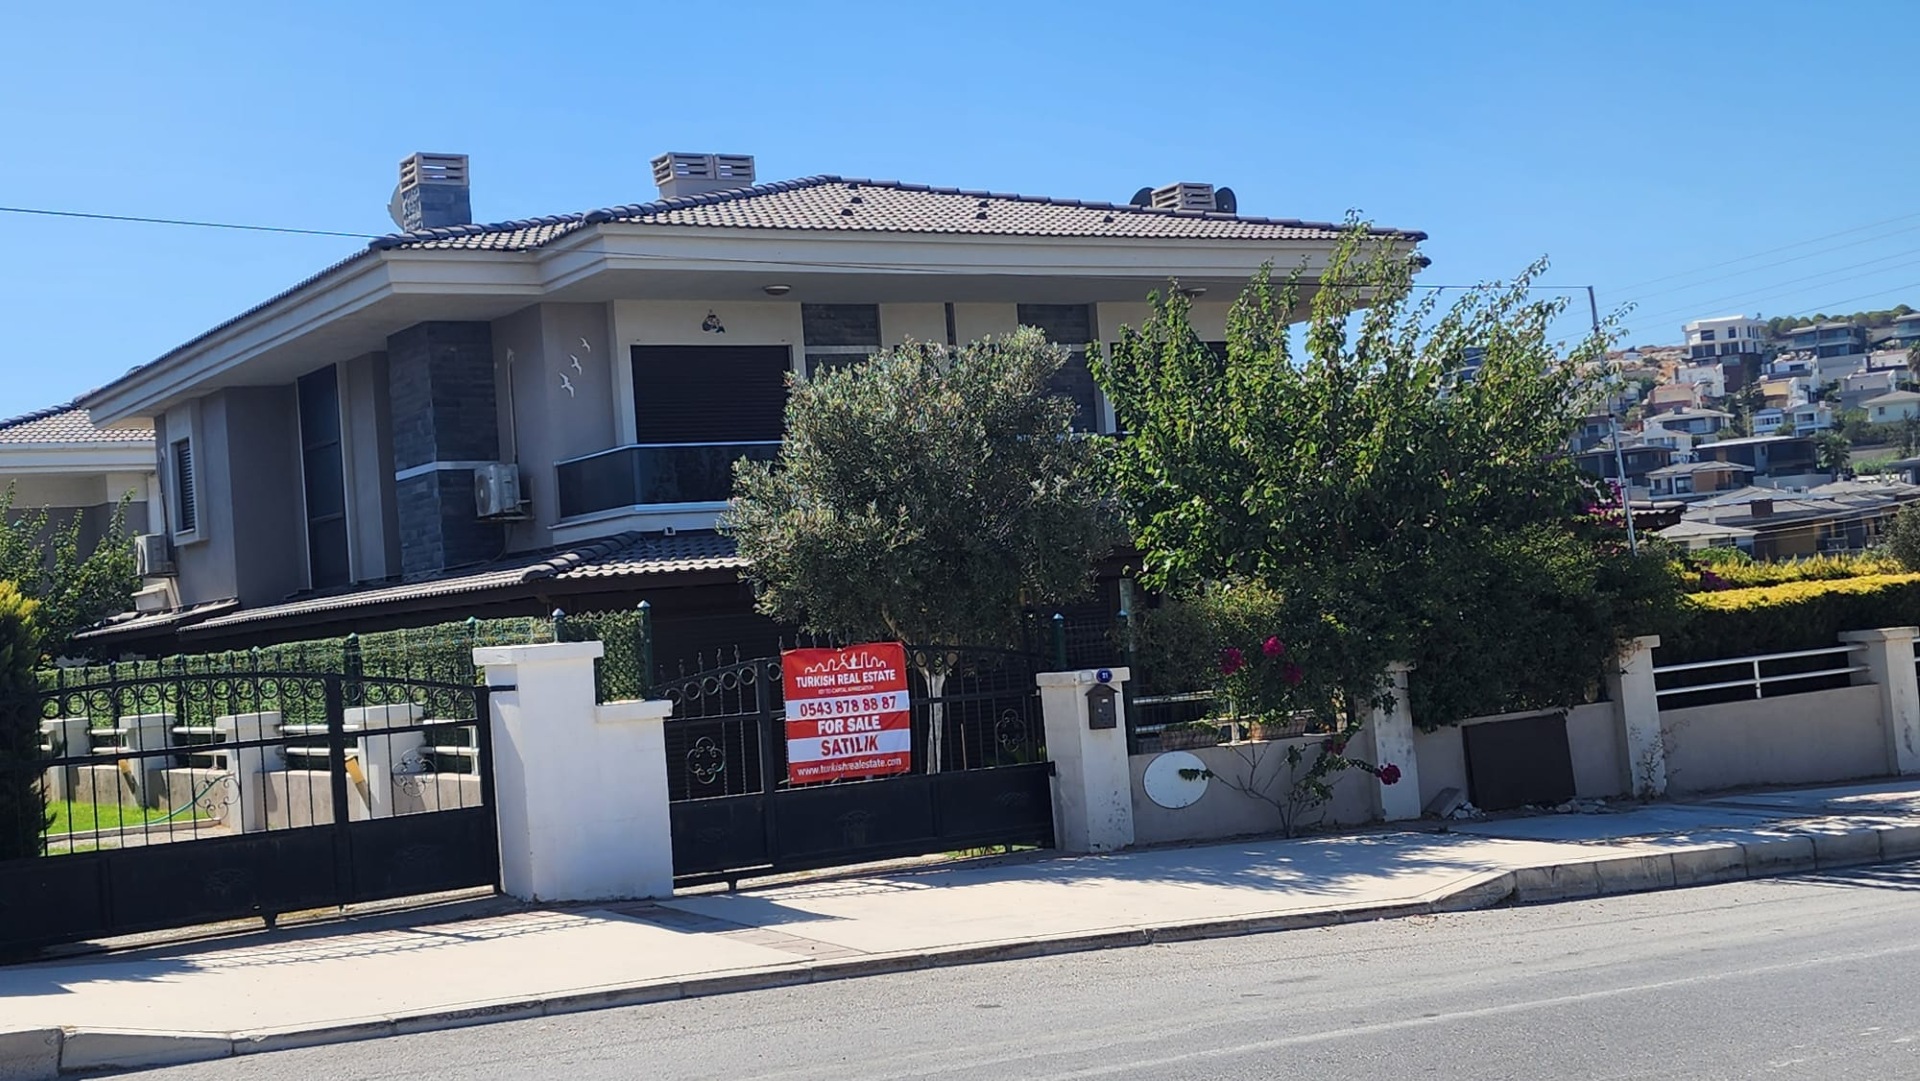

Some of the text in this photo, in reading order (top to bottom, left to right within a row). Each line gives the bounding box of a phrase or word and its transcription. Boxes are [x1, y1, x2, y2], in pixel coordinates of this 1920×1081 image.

[796, 669, 896, 688] TURKISH REAL ESTATE
[800, 695, 897, 717] 0543 878 88 87
[817, 715, 881, 735] FOR SALE
[821, 735, 879, 756] SATILIK
[797, 757, 902, 776] www.turkishrealestate.com
